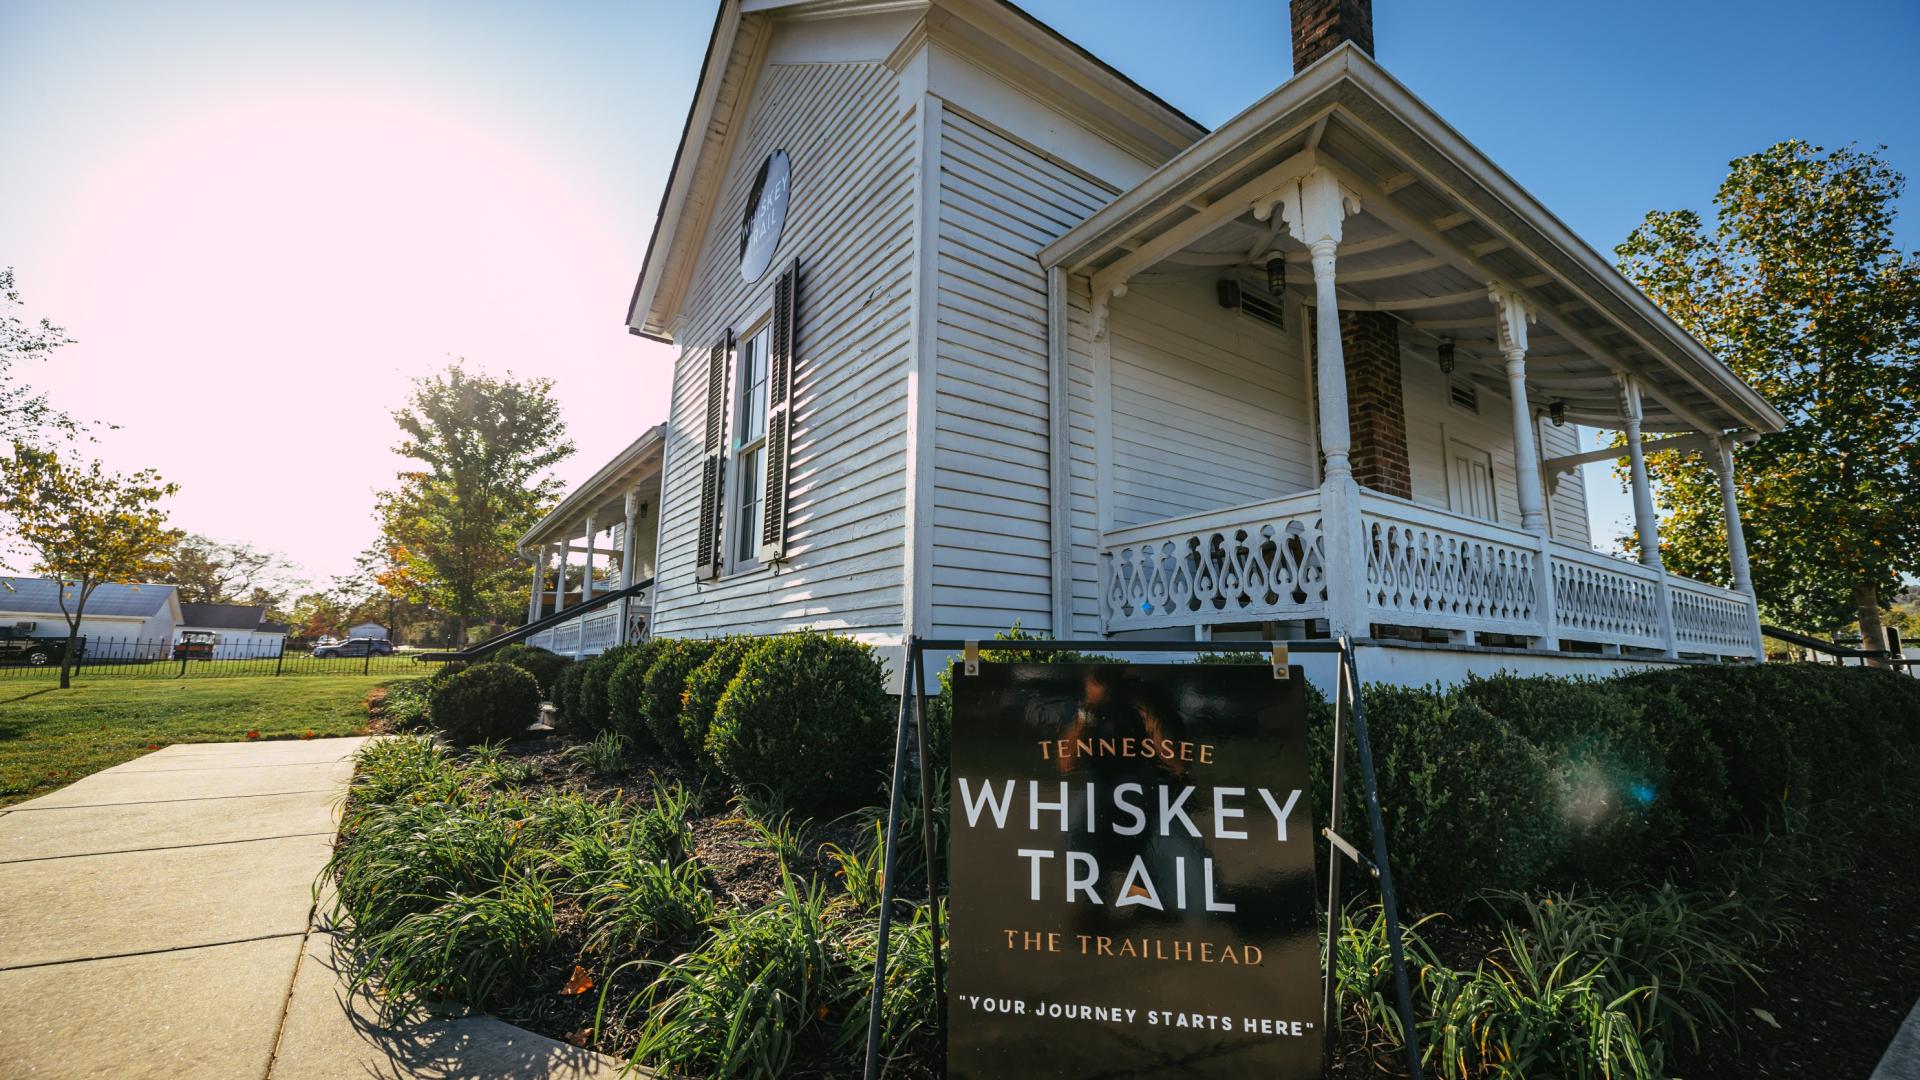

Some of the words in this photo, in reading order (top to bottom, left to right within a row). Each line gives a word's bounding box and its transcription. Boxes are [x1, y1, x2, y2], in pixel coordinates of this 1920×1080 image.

[741, 171, 789, 239] WHISKEY
[1038, 737, 1215, 765] TENNESSEE
[958, 778, 1302, 842] WHISKEY
[1018, 848, 1236, 913] TRAIL
[1004, 929, 1061, 953] THE
[1077, 935, 1263, 965] TRAILHEAD
[959, 995, 1025, 1015] "YOUR
[1035, 1002, 1136, 1024] JOURNEY
[1148, 1010, 1233, 1032] STARTS
[1244, 1018, 1315, 1037] HERE"
